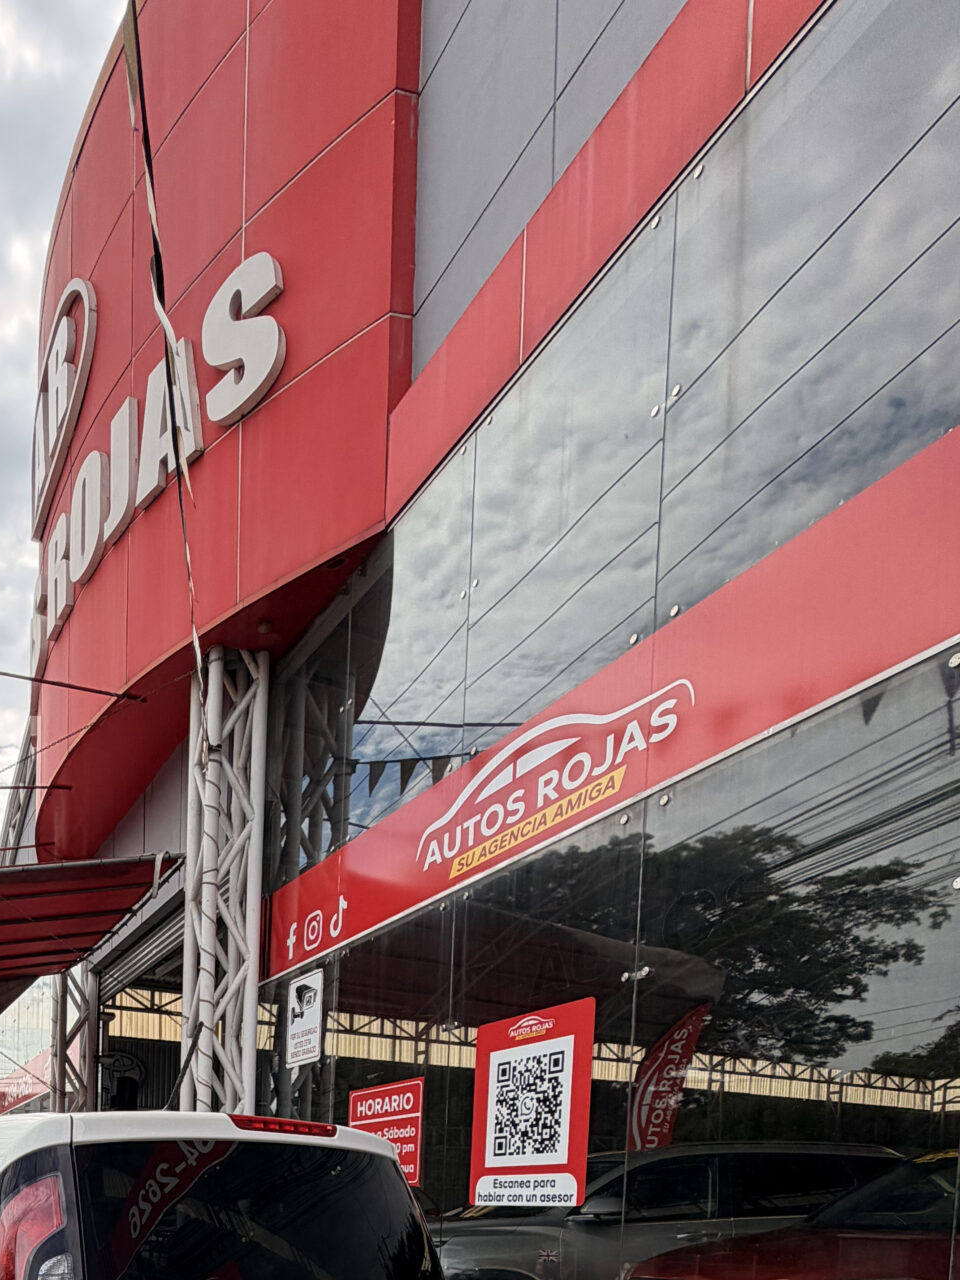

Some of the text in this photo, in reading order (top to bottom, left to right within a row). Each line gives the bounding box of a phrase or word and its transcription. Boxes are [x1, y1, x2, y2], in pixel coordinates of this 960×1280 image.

[47, 251, 286, 641] ROJAS
[423, 699, 678, 872] AUTOS ROJAS
[456, 774, 617, 873] SU AGENCIA AMIGA
[510, 1027, 530, 1037] AUTOS
[532, 1021, 553, 1031] ROJAS
[645, 1028, 688, 1149] UTOS ROJAS
[357, 1092, 413, 1117] HORARIO
[383, 1125, 416, 1139] Sábado
[402, 1145, 415, 1155] pm
[493, 1178, 556, 1190] Escanea para
[477, 1192, 574, 1203] hablar con un asesor
